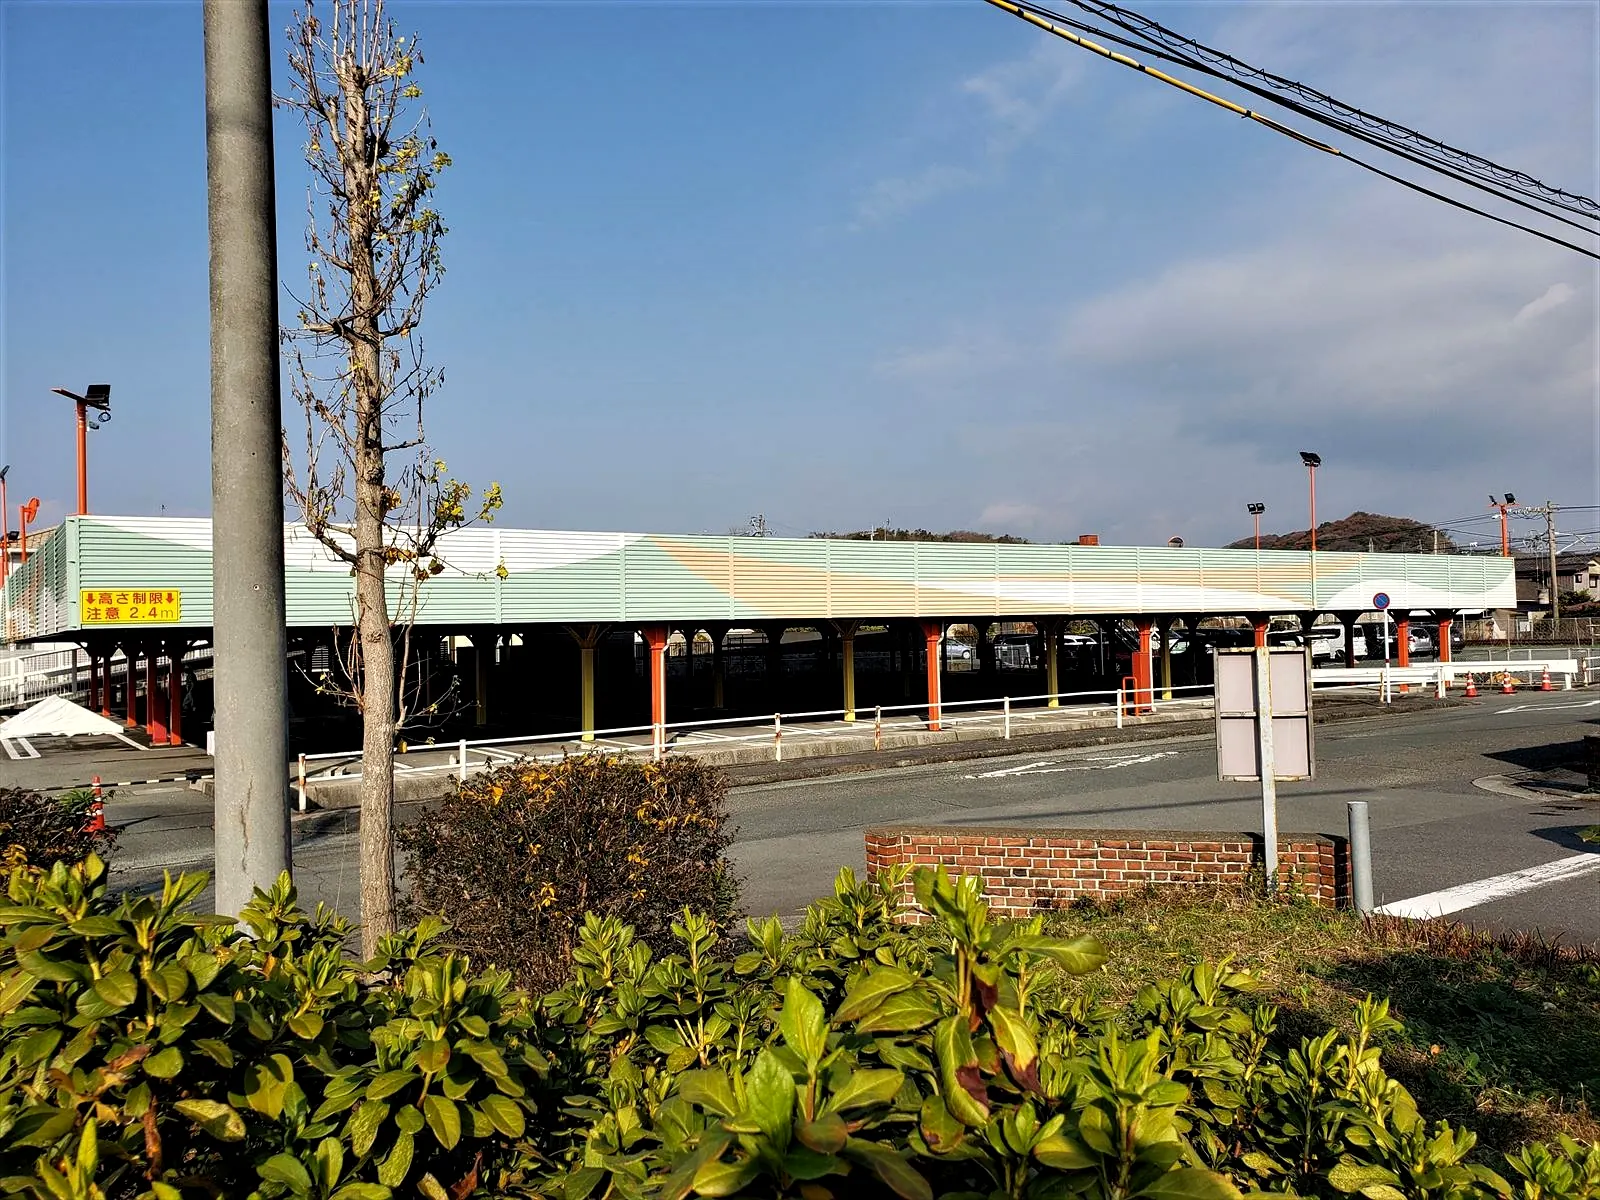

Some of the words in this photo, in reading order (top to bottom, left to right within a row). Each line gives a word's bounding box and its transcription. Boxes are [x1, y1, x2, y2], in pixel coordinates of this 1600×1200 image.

[98, 592, 163, 605] 高さ制限
[86, 607, 120, 620] 注意
[129, 606, 174, 619] 2.4m
